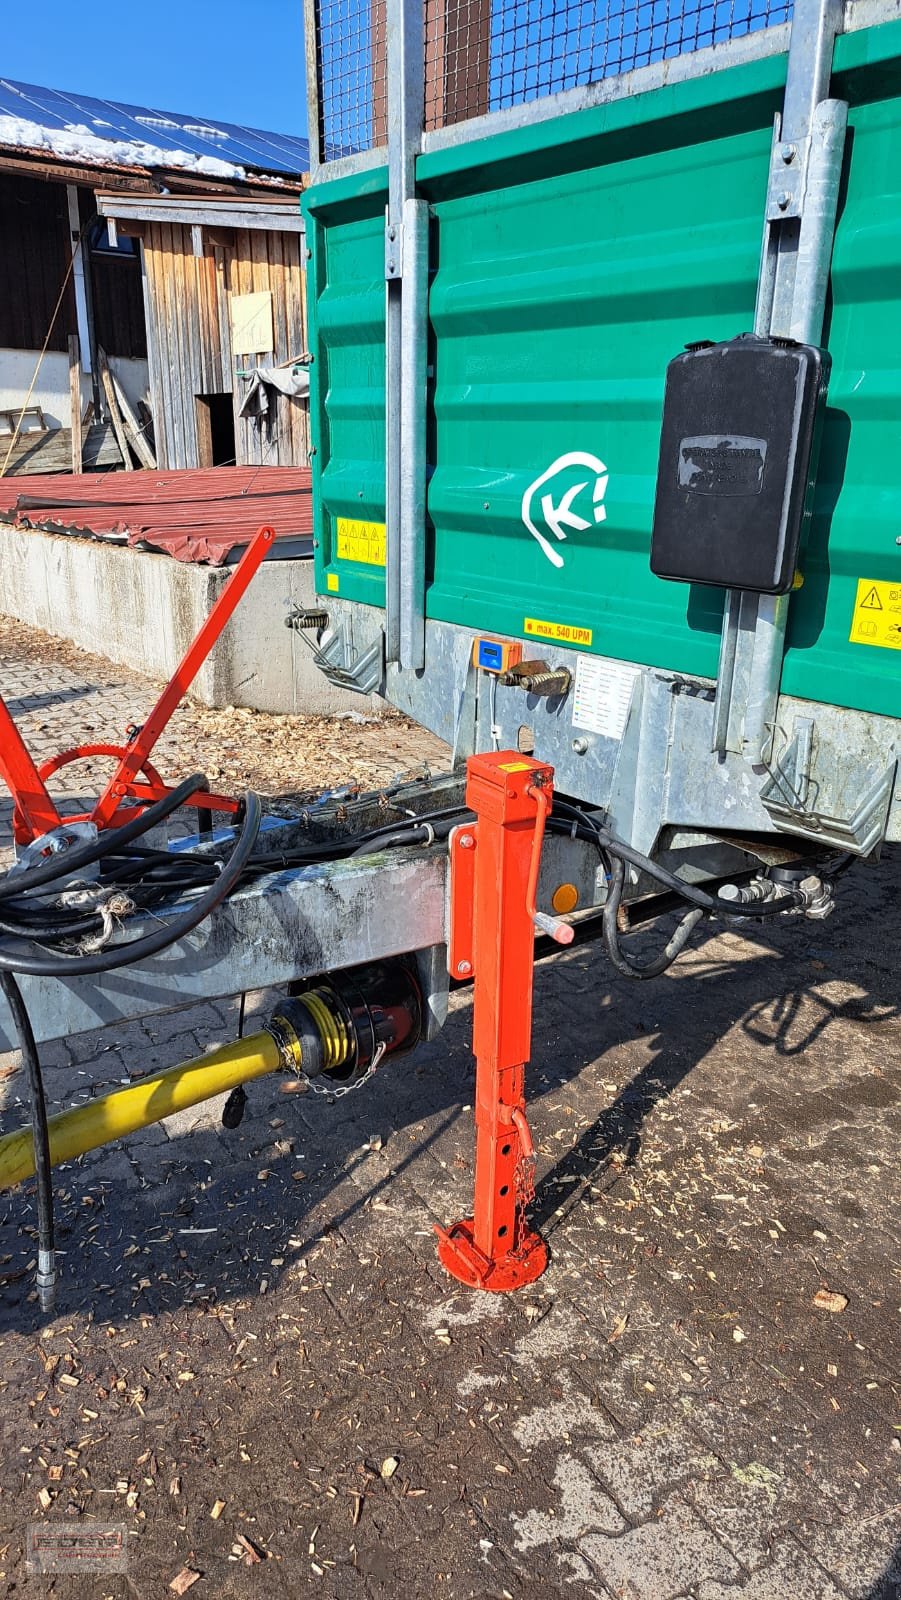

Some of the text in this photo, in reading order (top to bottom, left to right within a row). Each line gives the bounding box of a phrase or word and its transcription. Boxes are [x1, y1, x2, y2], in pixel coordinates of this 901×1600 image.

[537, 624, 590, 643] max. 540 UPM
